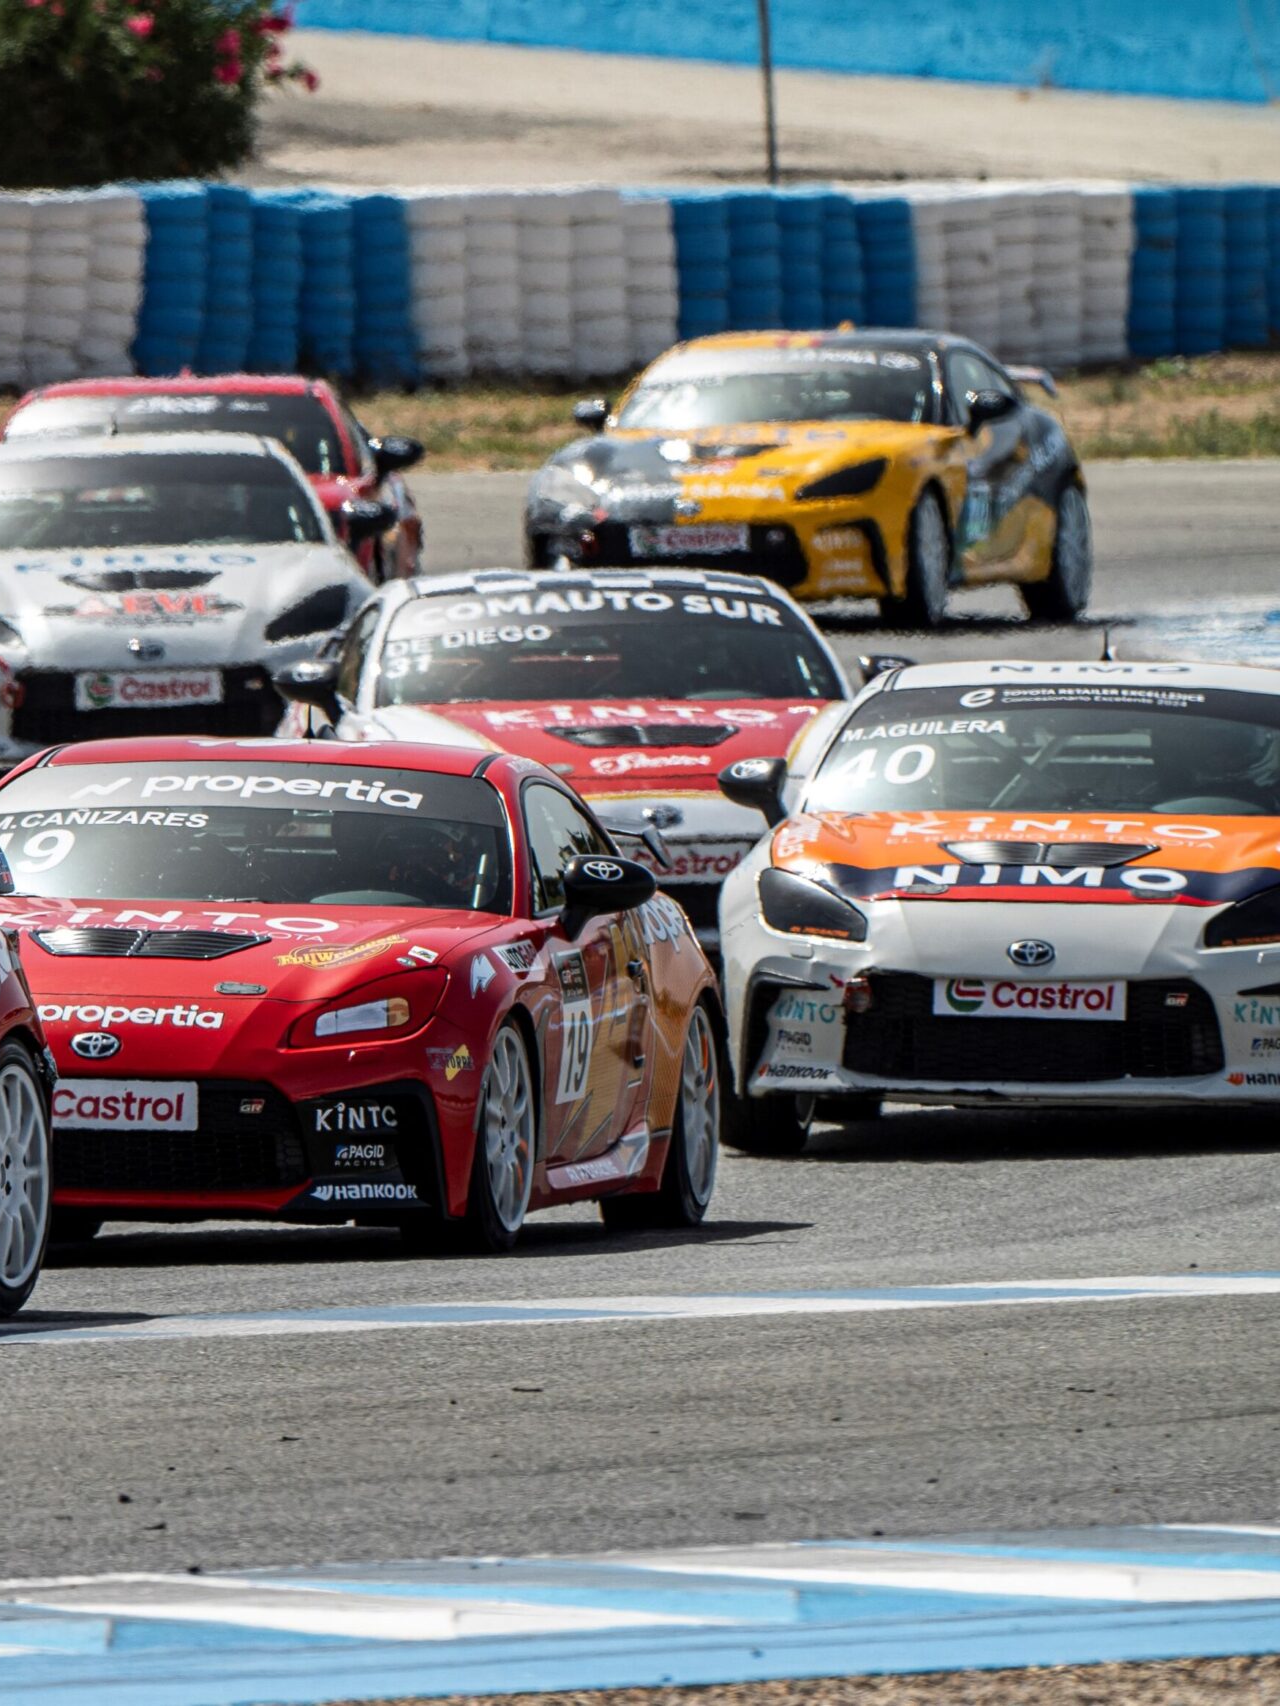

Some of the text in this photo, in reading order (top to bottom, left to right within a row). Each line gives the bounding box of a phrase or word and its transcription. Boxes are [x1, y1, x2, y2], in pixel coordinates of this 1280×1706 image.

[417, 590, 783, 626] COMAUTO SUR
[387, 624, 552, 657] DE DIEGO
[386, 653, 434, 679] 31
[120, 676, 211, 701] Castrol
[1002, 687, 1206, 703] TOYOTA RETAILER EXCELLENCE
[828, 743, 936, 788] 40
[142, 772, 424, 811] propertia
[894, 863, 1189, 891] NIMO
[992, 980, 1116, 1011] Castrol
[37, 1003, 225, 1030] propertia
[564, 1010, 590, 1094] 19
[52, 1088, 184, 1122] Castrol
[334, 1159, 386, 1168] RACING
[349, 1144, 385, 1159] PAGID
